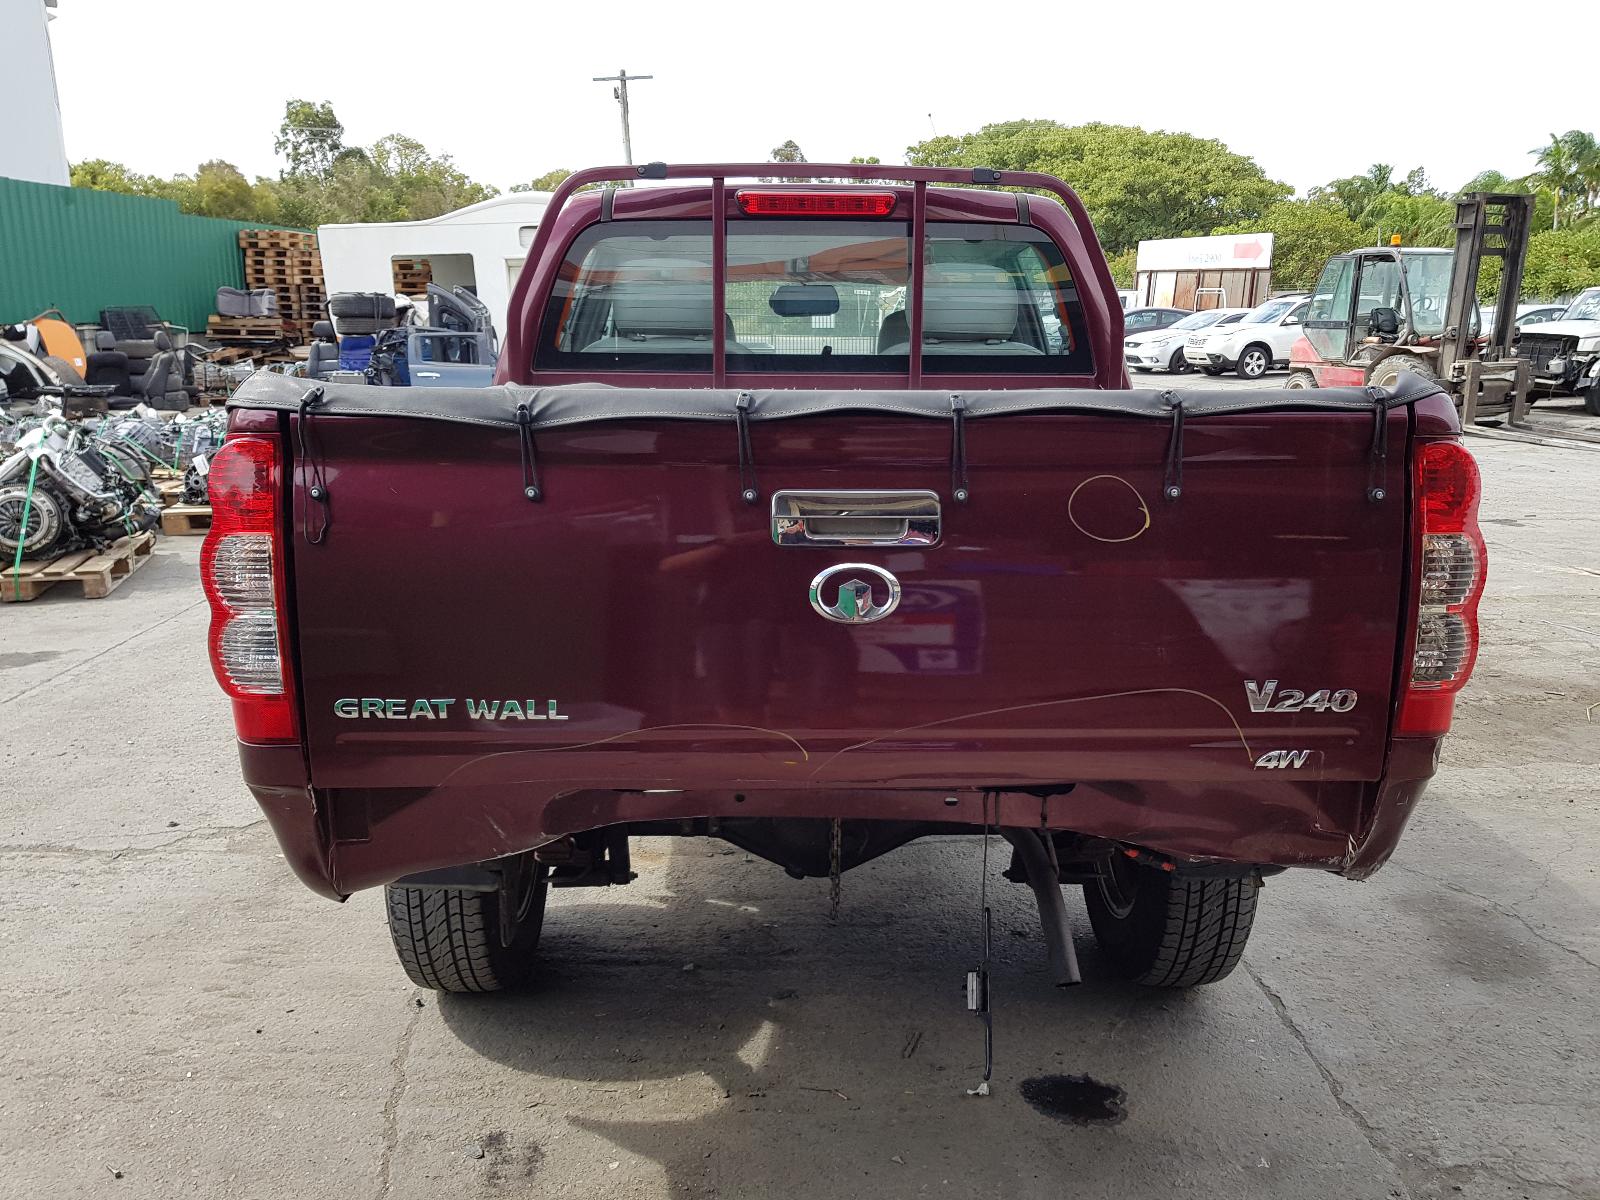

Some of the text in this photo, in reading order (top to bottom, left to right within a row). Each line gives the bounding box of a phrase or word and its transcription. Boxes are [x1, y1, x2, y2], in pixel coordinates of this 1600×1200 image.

[1244, 680, 1357, 713] V240
[333, 698, 569, 720] GREAT WALL
[1255, 750, 1311, 769] 4W
